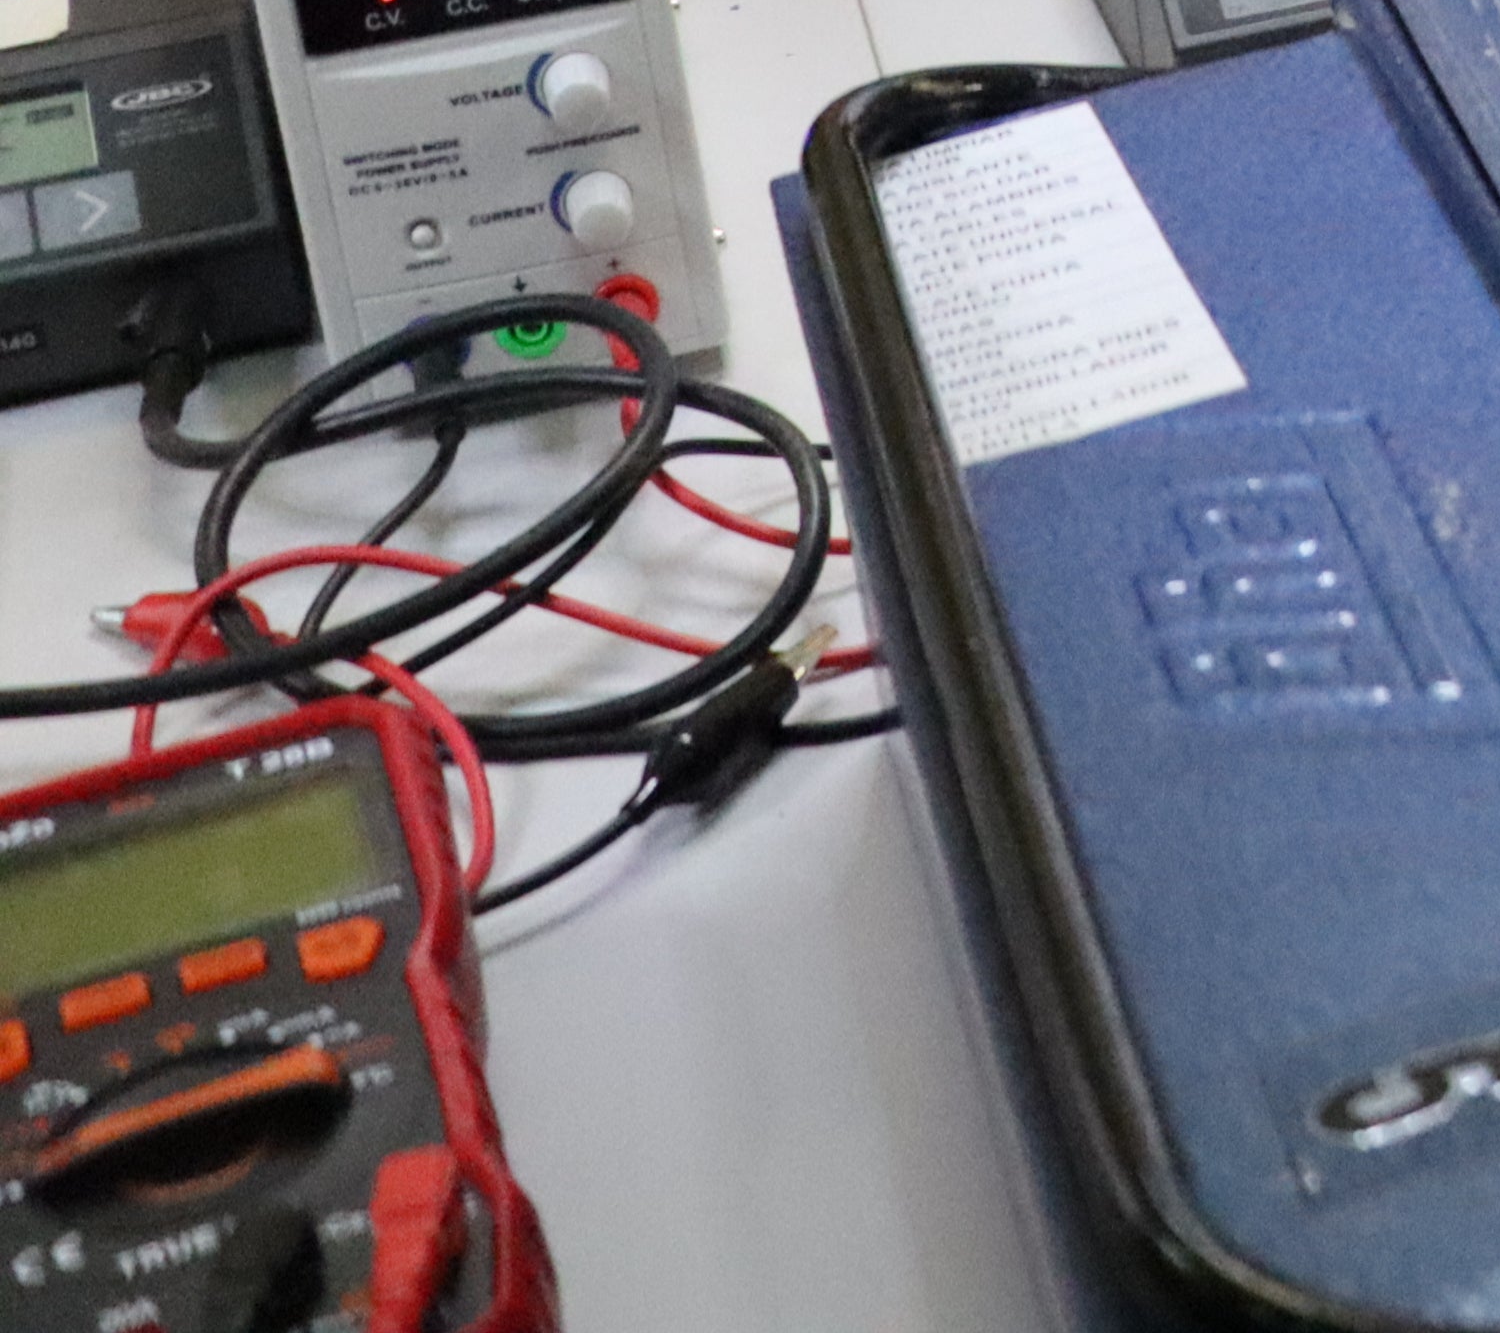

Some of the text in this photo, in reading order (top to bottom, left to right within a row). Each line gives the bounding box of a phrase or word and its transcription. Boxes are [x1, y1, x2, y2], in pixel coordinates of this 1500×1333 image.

[450, 83, 524, 108] VOLTAGE
[356, 162, 406, 179] POWER
[906, 152, 1031, 192] AISLANTE
[933, 173, 1077, 219] ALAMBRES
[468, 202, 546, 228] CURRENT
[969, 201, 1112, 246] UNIVERSAL
